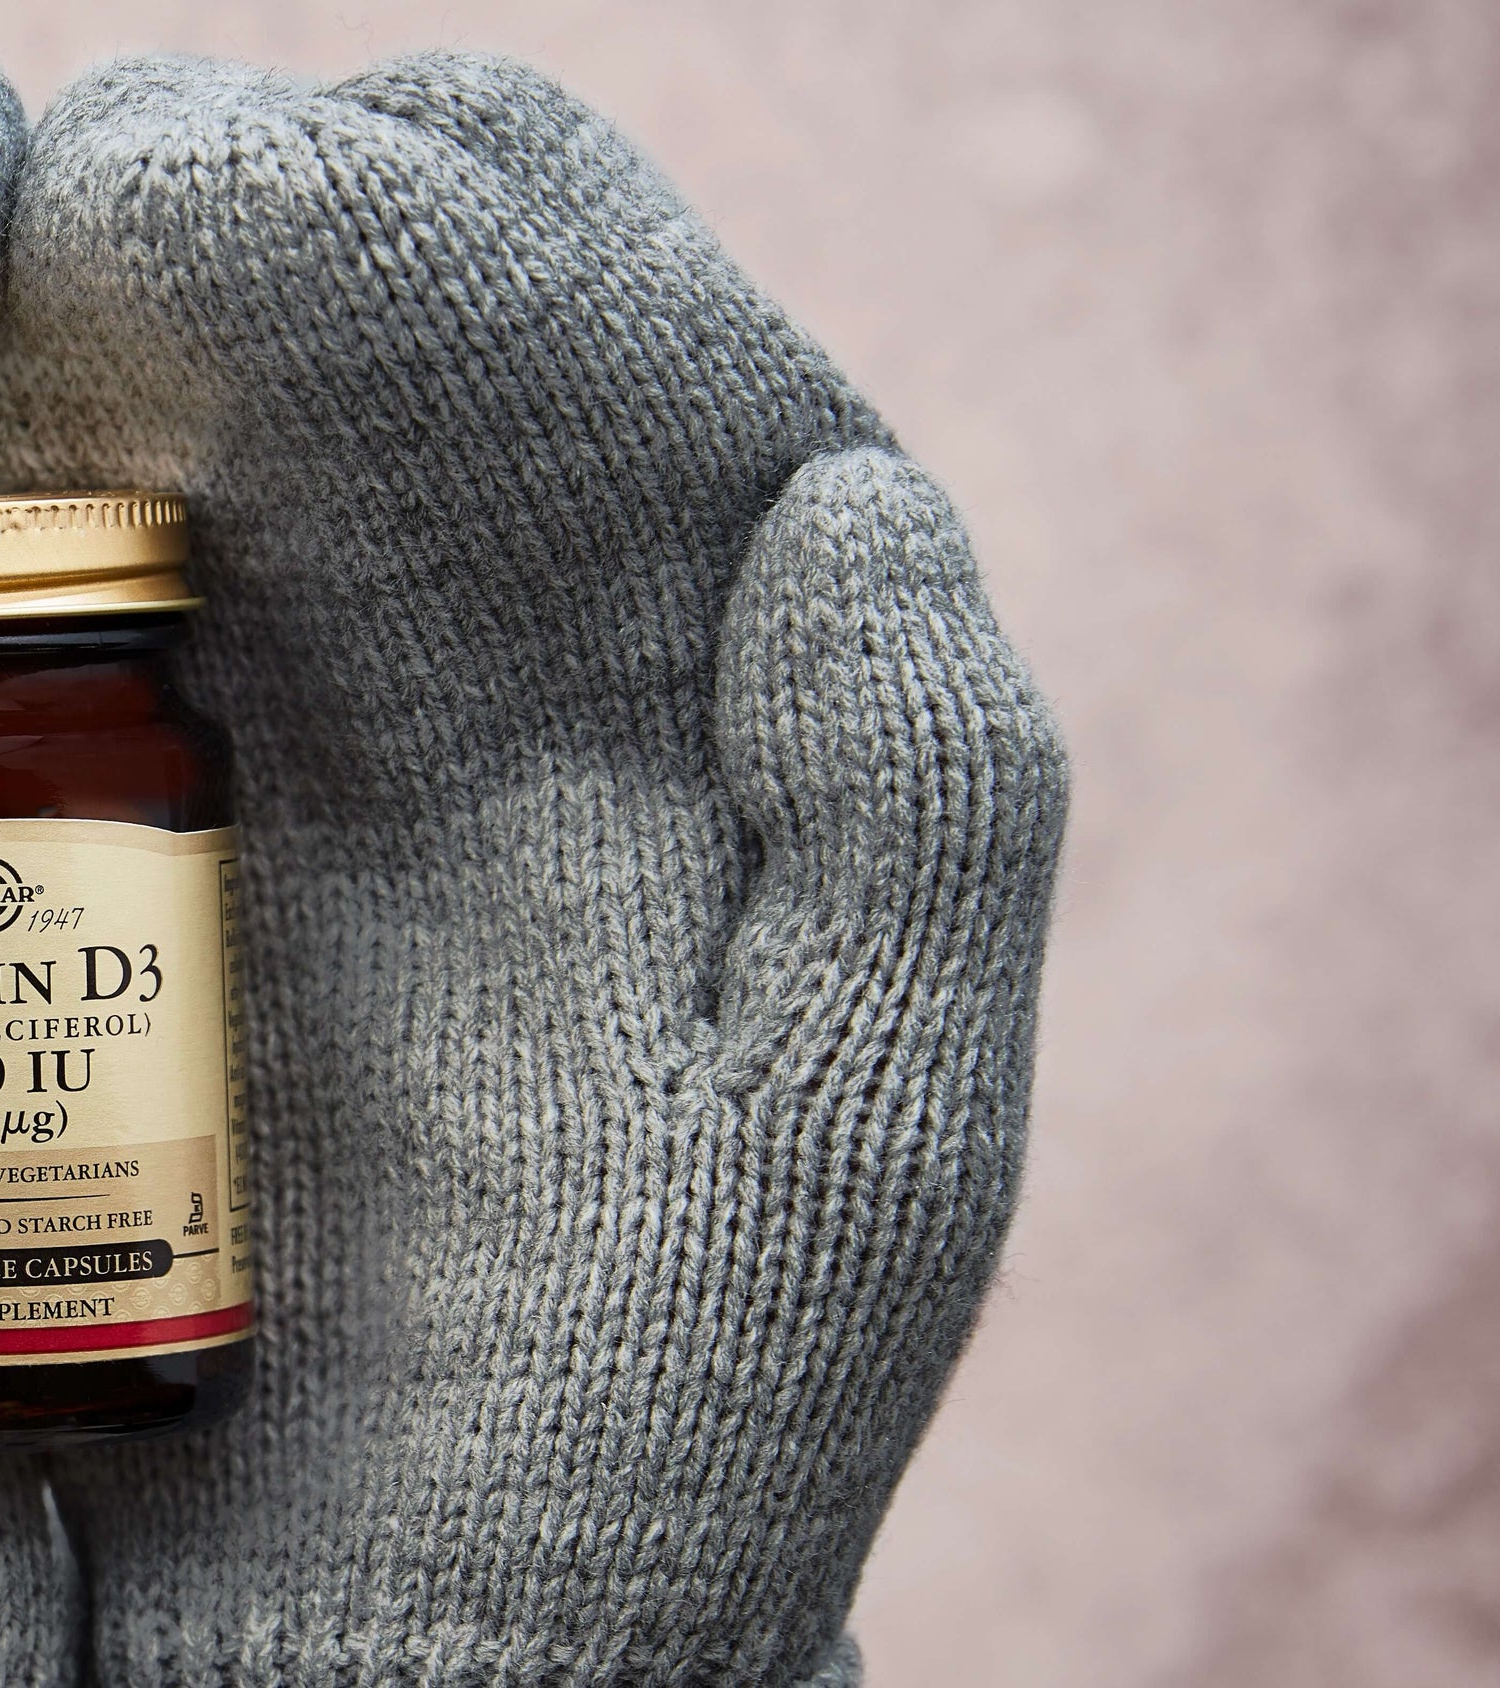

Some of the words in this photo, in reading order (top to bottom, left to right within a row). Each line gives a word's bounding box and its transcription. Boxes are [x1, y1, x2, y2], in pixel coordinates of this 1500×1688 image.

[27, 907, 85, 934] 1947
[77, 943, 163, 1003] D3
[26, 1048, 96, 1094] IU
[17, 1213, 102, 1235] STARCH
[106, 1209, 153, 1229] FREE
[182, 1222, 209, 1237] PARVE
[25, 1250, 153, 1279] CAPSULES
